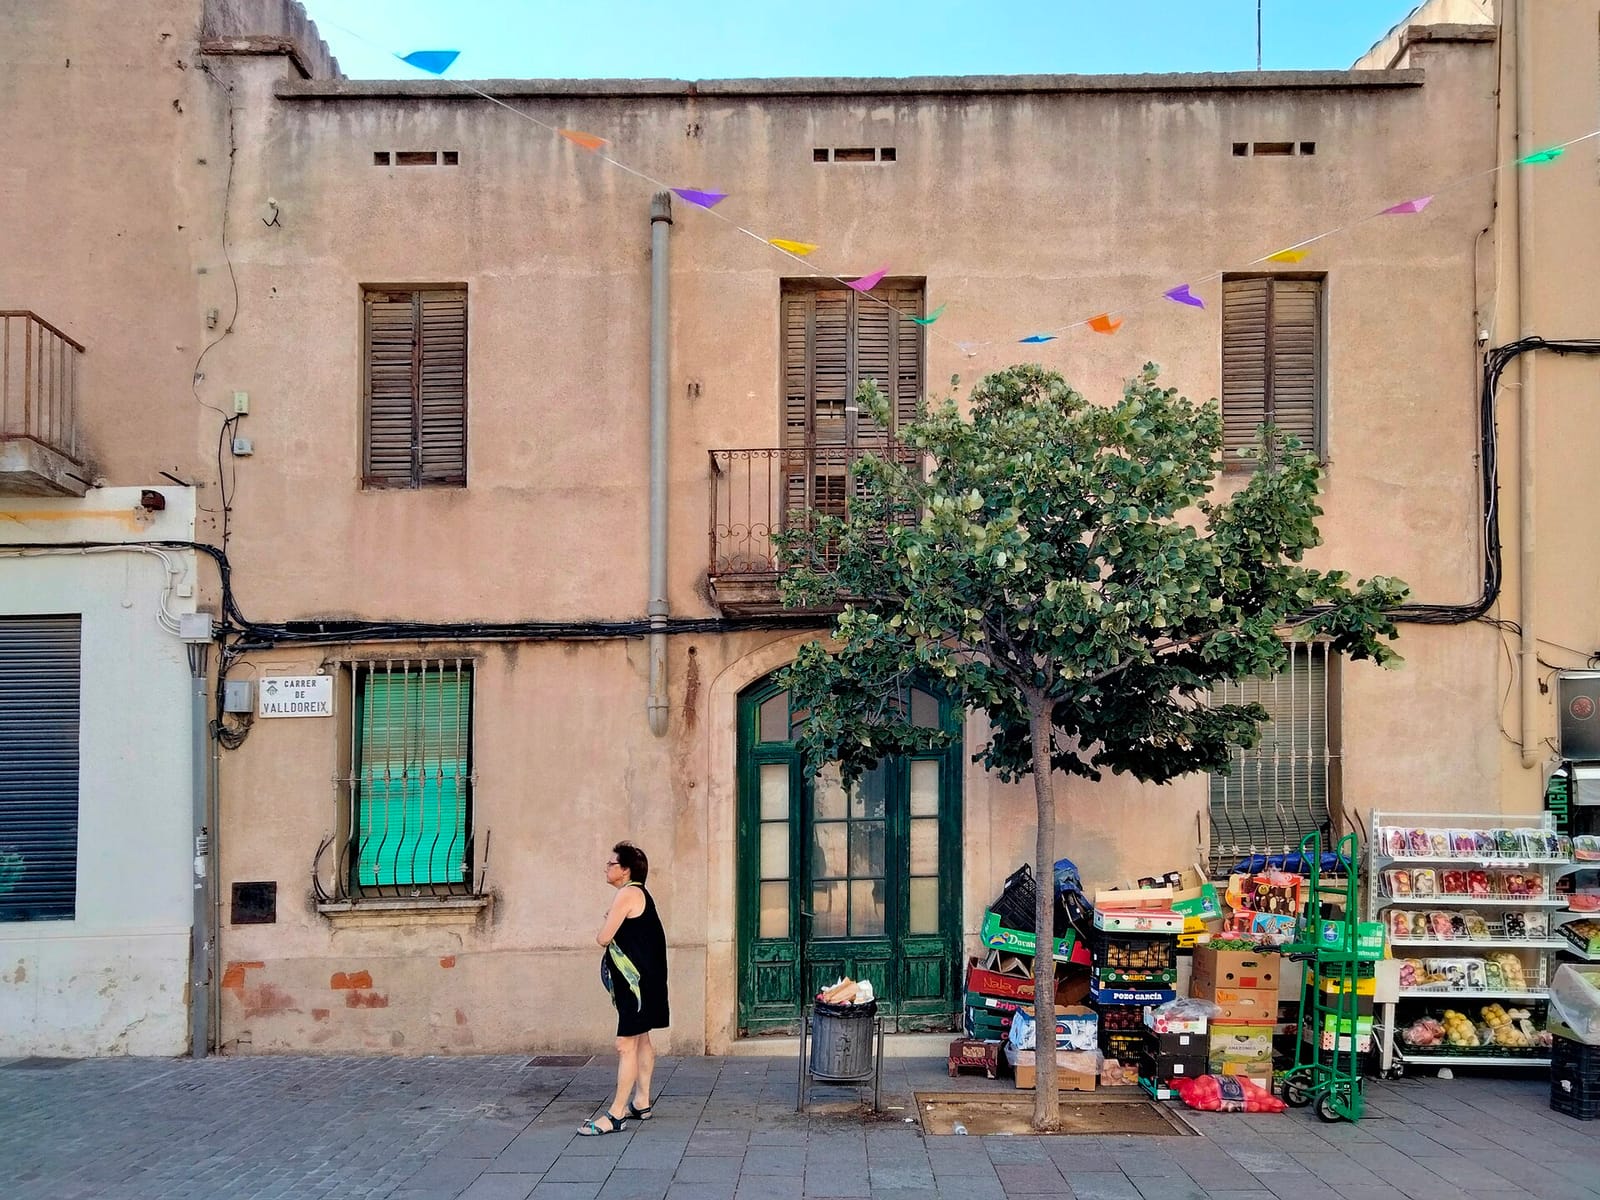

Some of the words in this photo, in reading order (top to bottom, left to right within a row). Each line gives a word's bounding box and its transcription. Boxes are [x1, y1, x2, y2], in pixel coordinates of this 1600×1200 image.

[284, 680, 317, 688] CARRER
[295, 691, 305, 699] DE
[264, 701, 327, 713] VALLDOREIX
